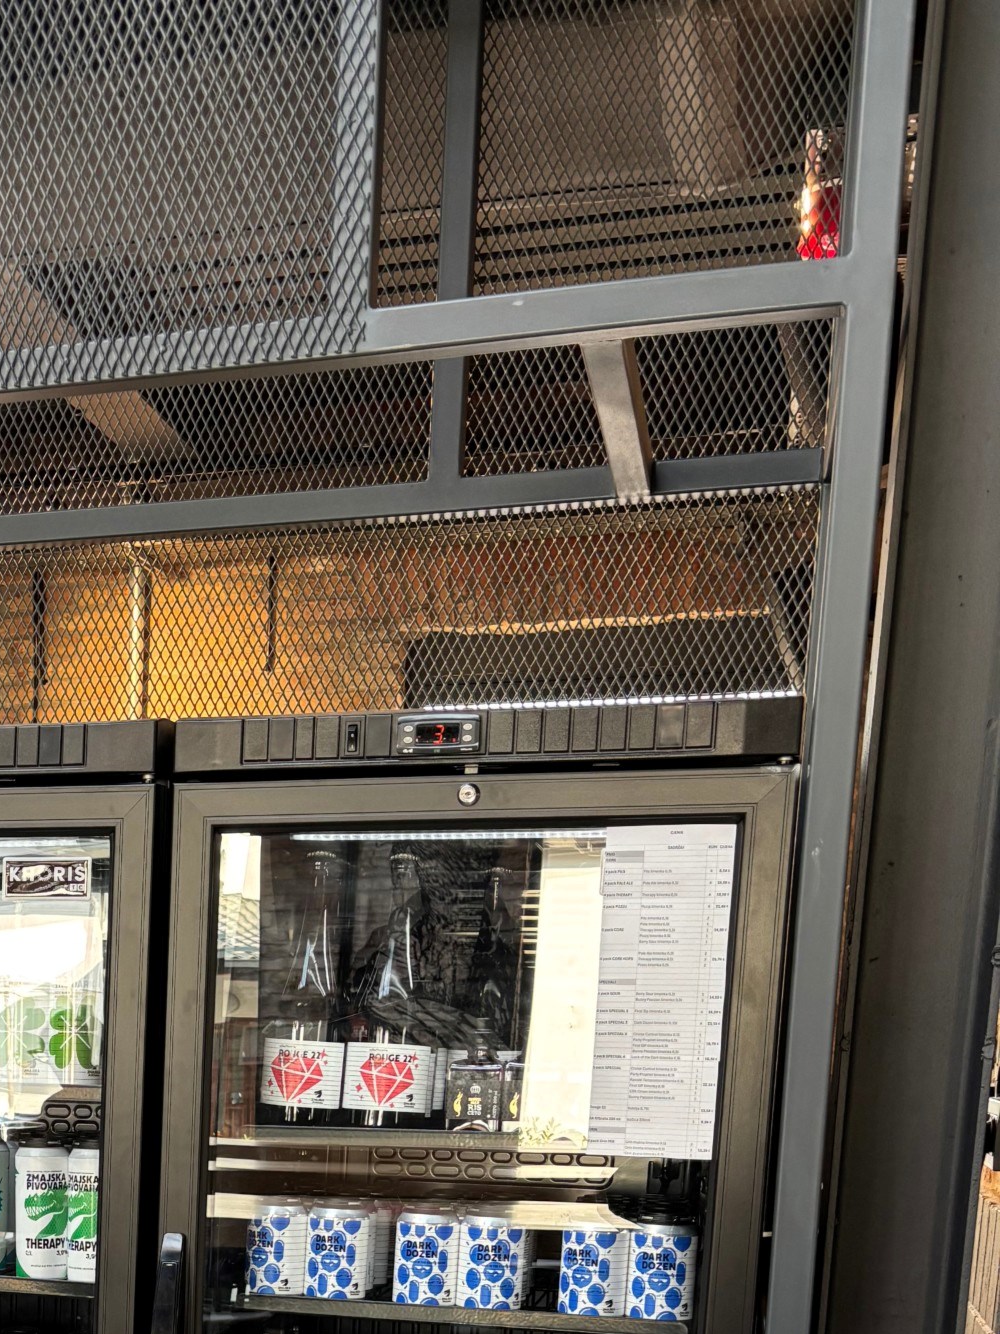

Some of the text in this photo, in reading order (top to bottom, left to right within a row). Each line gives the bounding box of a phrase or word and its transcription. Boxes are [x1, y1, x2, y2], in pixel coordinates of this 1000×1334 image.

[433, 725, 444, 745] 3
[369, 1053, 400, 1062] ROUGE
[403, 1055, 412, 1063] 22
[26, 1174, 66, 1182] ZMAJSKA
[26, 1182, 68, 1190] PIVOVARA
[26, 1238, 66, 1249] THERAPY
[315, 1234, 339, 1244] DARK
[315, 1243, 346, 1252] DOZEN
[406, 1240, 432, 1249] DARK
[477, 1244, 503, 1253] DARK
[406, 1249, 438, 1258] DOZEN
[477, 1252, 510, 1262] DOZEN
[568, 1249, 592, 1258] DARK
[642, 1252, 669, 1262] DARK
[568, 1257, 598, 1267] DOZEN
[642, 1261, 676, 1271] DOZEN
